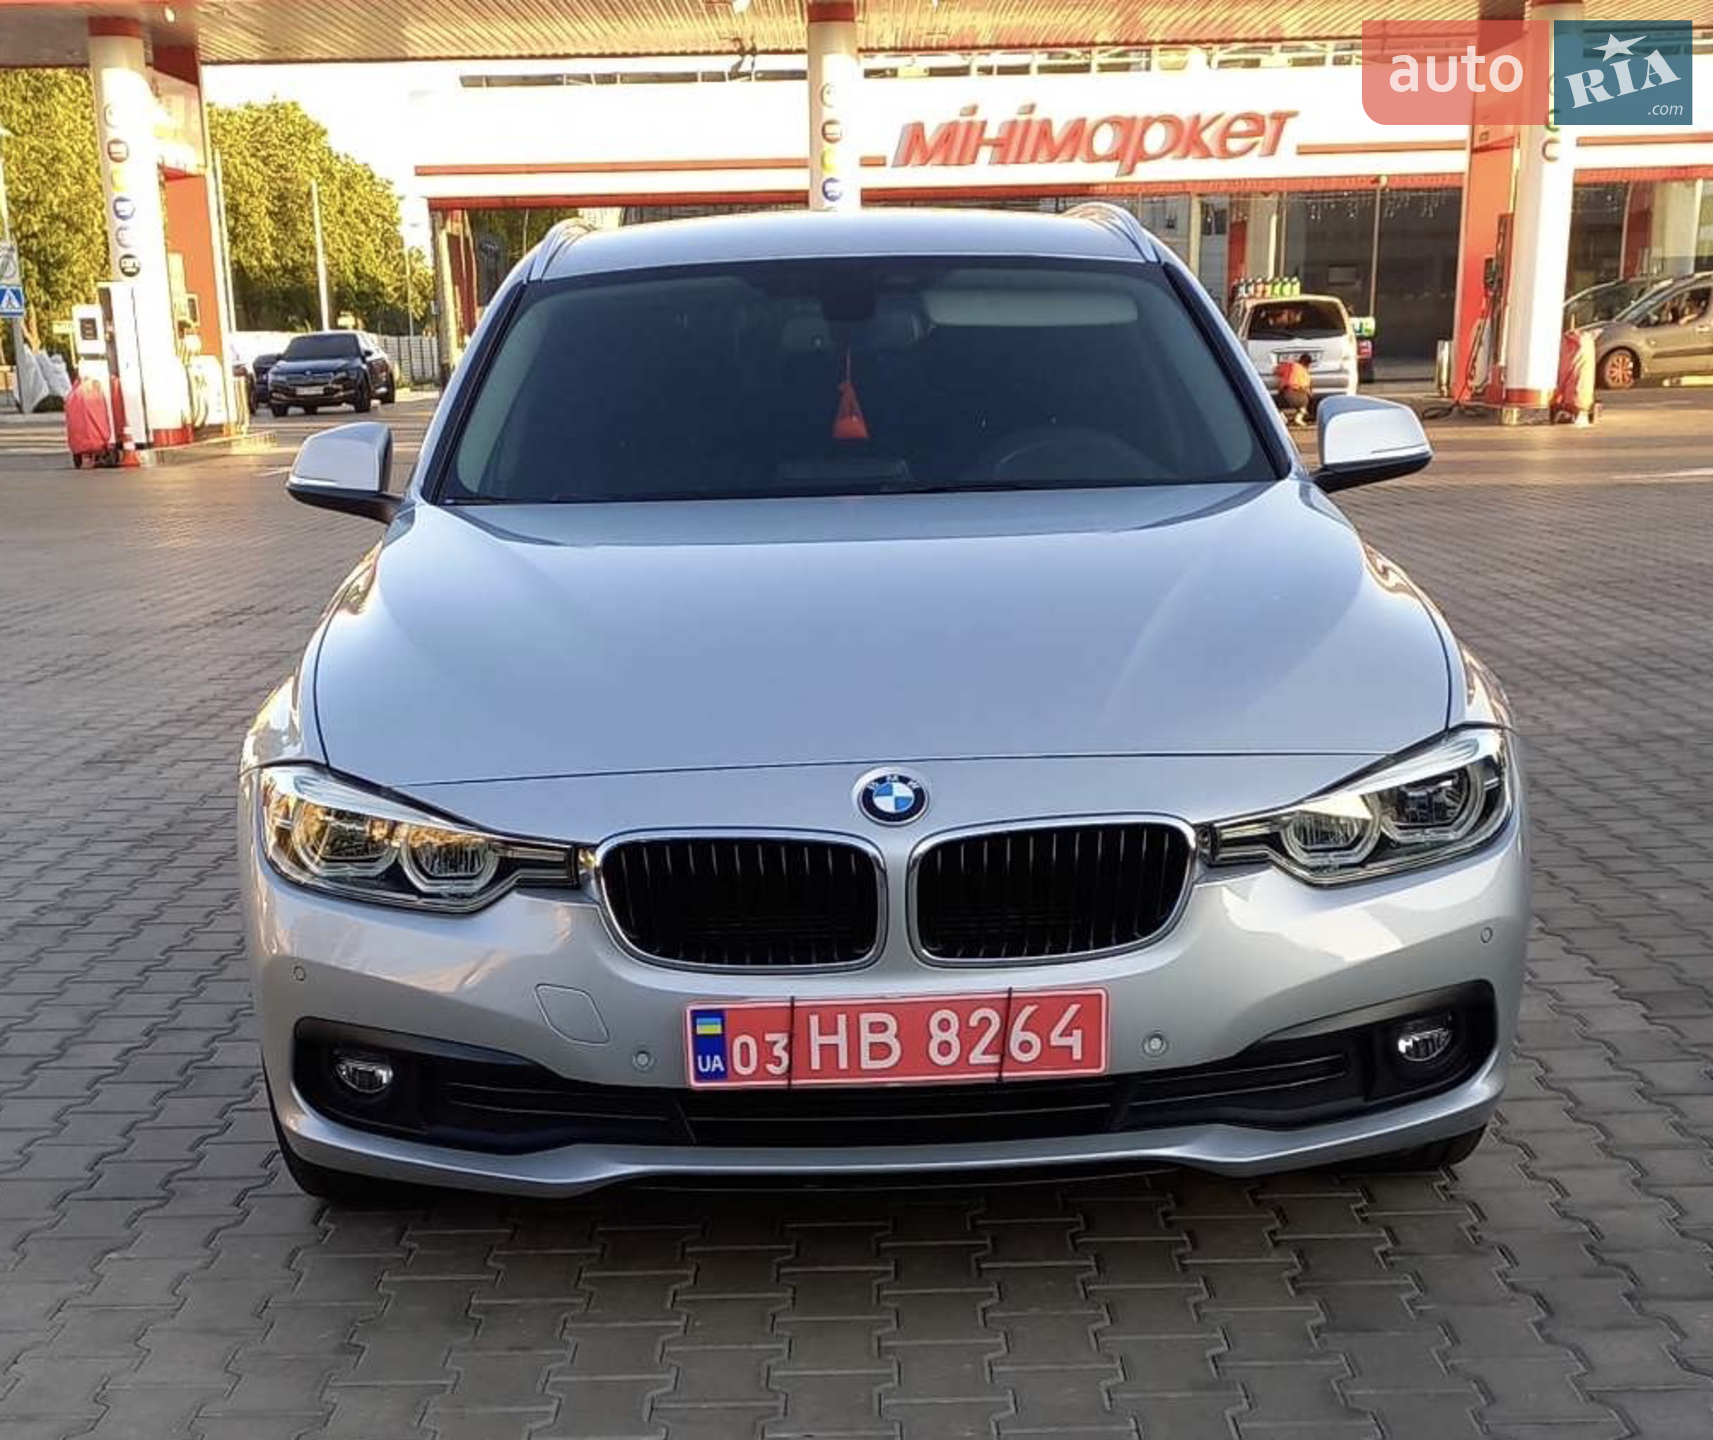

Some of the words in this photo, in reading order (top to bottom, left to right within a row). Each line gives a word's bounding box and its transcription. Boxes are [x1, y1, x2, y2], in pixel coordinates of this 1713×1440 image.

[893, 103, 1300, 178] мінімаркет
[697, 1054, 725, 1073] UA
[732, 1032, 790, 1077] 03
[808, 1011, 901, 1071] HB
[927, 1003, 1083, 1066] 8264
